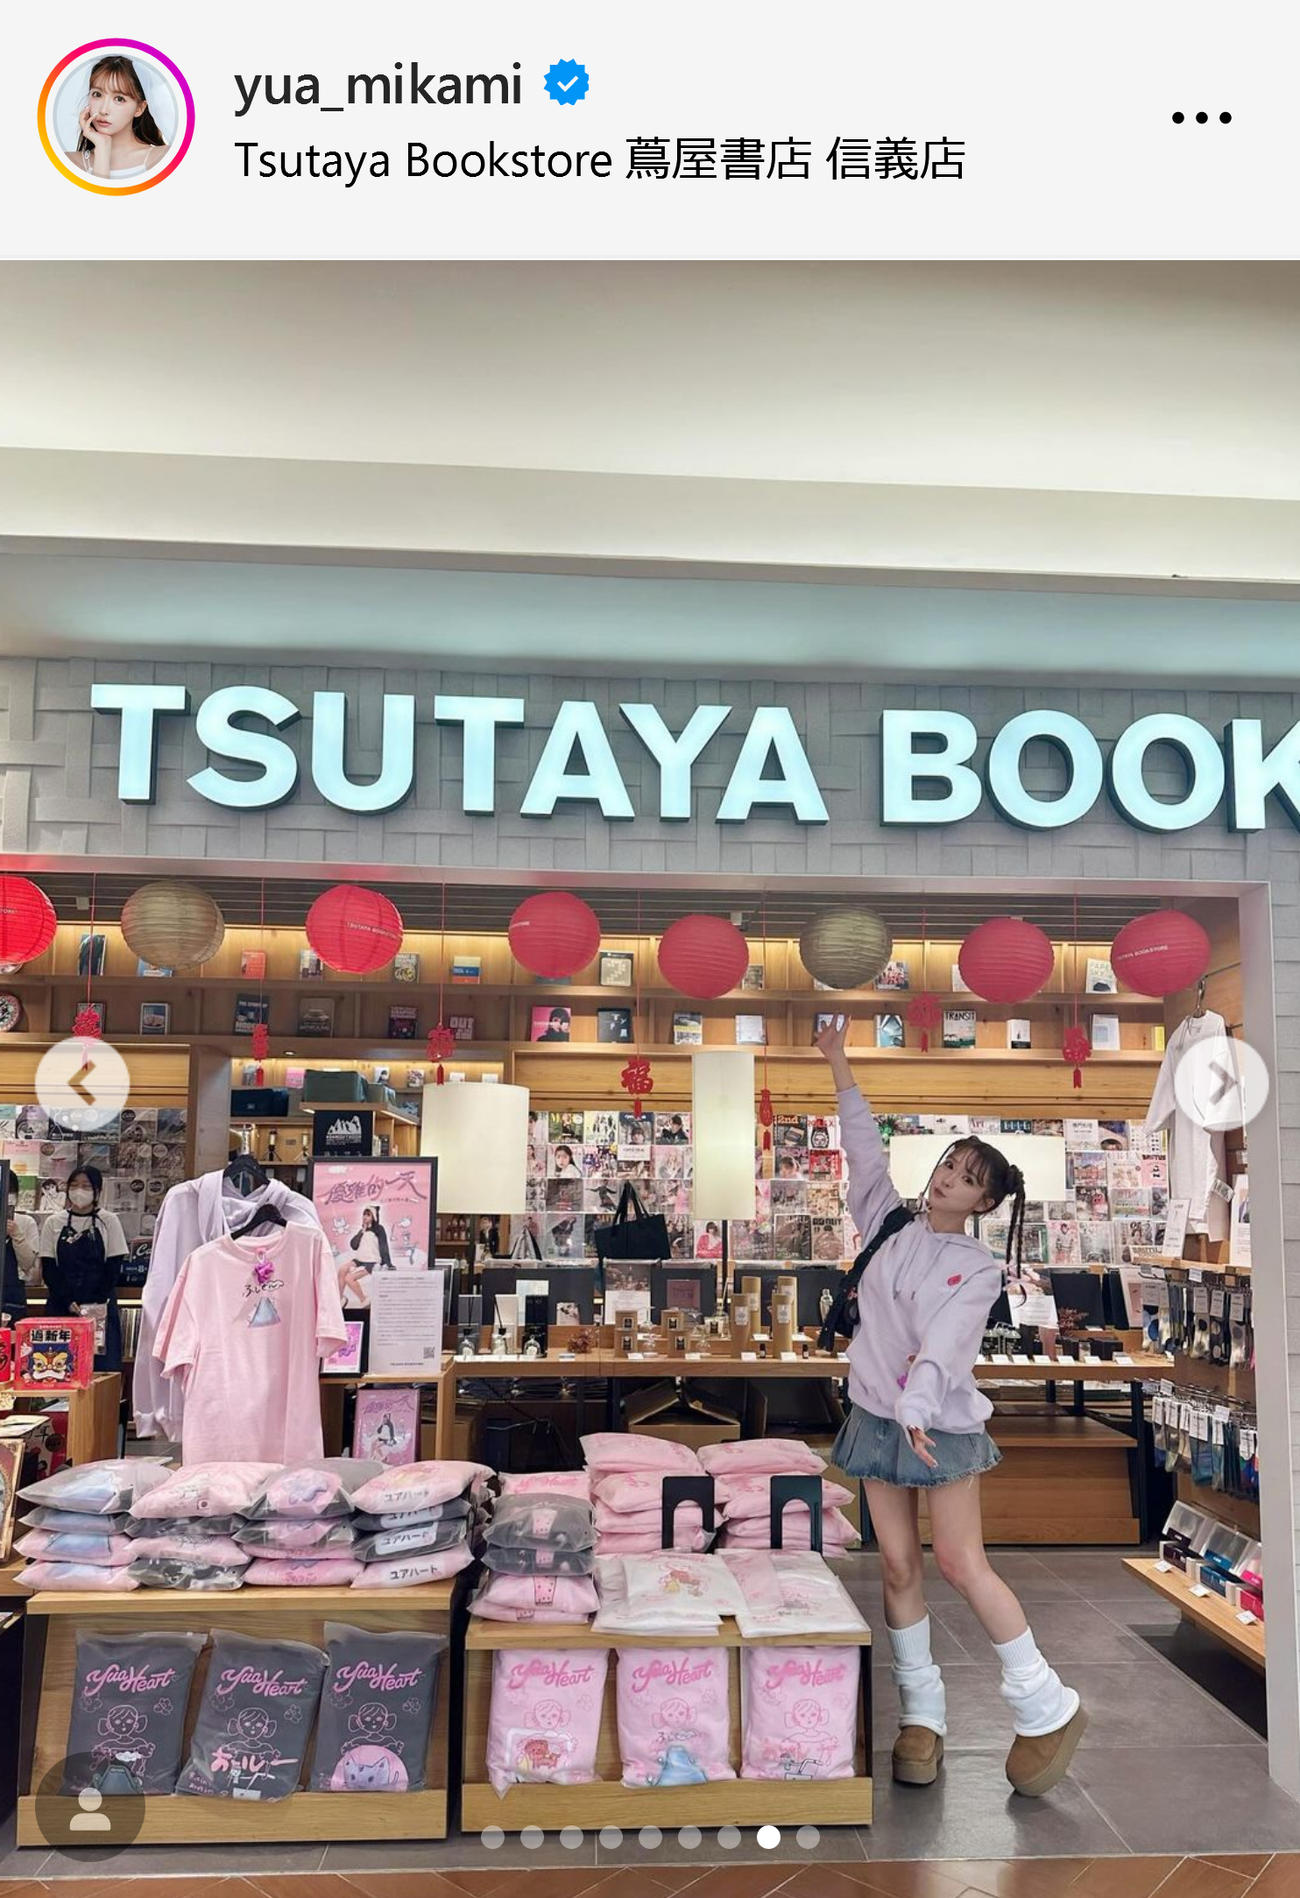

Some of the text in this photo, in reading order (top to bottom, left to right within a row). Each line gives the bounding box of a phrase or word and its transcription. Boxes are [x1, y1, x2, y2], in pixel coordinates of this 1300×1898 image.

[90, 683, 829, 825] TSUTAYA
[945, 1010, 976, 1021] TRANSIT
[621, 1058, 653, 1094] 福
[777, 1115, 799, 1125] 2nd
[389, 1564, 439, 1580] ユアハート
[84, 1664, 176, 1697] Yua Heart
[216, 1665, 308, 1697] Yua Heart
[332, 1660, 424, 1693] Yua Heart
